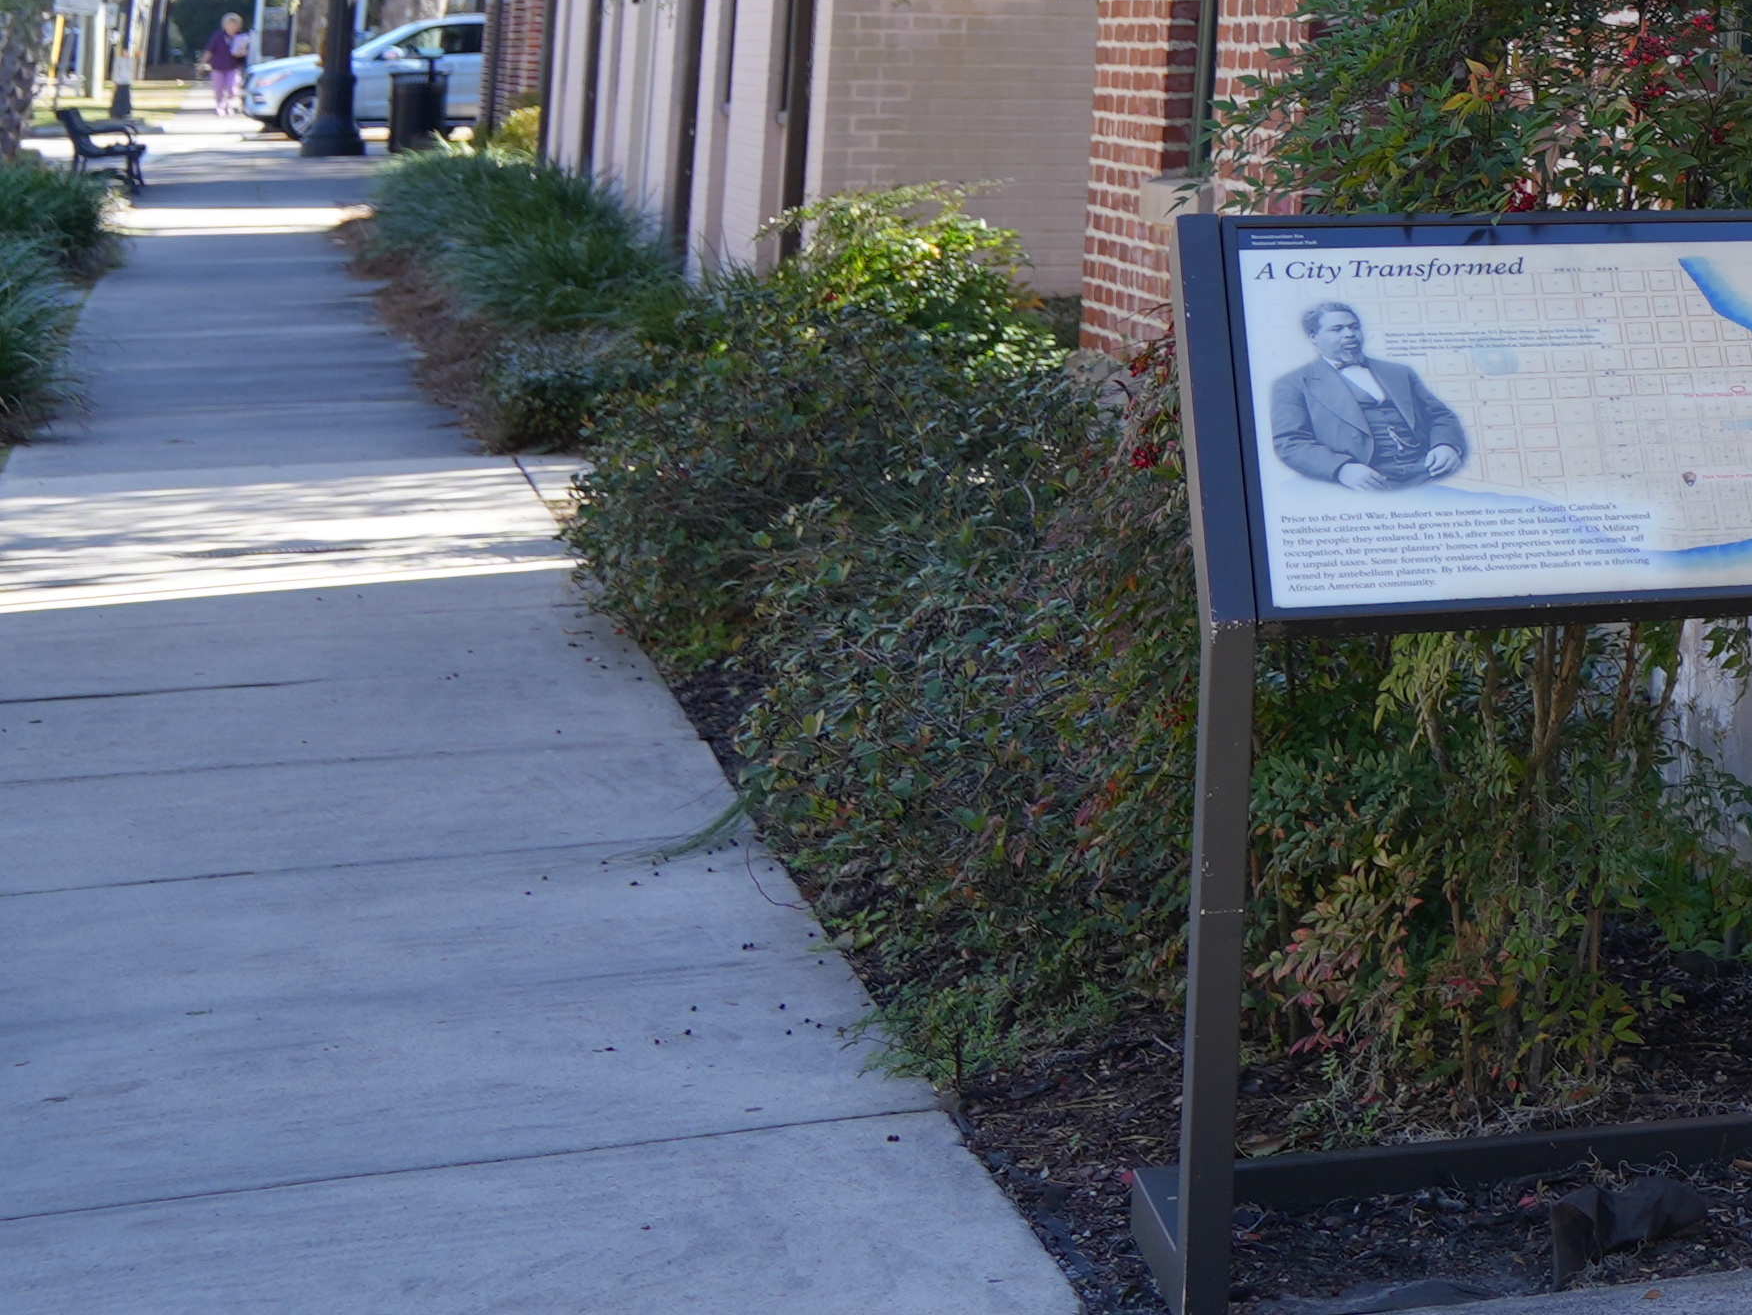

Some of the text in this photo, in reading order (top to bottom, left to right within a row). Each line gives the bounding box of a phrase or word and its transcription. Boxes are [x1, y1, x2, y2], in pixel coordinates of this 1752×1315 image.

[1254, 257, 1524, 283] A City Transformed
[1281, 515, 1305, 523] Prior
[1309, 514, 1319, 522] to
[1322, 513, 1337, 521] the
[1340, 512, 1362, 521] Civil
[1365, 512, 1388, 520] War,
[1390, 510, 1432, 519] Beaufort
[1526, 505, 1536, 513] of
[1538, 504, 1566, 513] South
[1569, 503, 1617, 511] Carolina's
[1282, 525, 1330, 534] wealthiest
[1334, 525, 1370, 533] citizens
[1373, 523, 1395, 531] who
[1398, 522, 1416, 530] had
[1418, 522, 1449, 531] grown
[1452, 519, 1471, 527] rich
[1474, 518, 1497, 526] from
[1500, 517, 1514, 525] the
[1538, 515, 1566, 523] Island
[1568, 514, 1602, 522] Cotton
[1605, 512, 1650, 521] harvested
[1284, 549, 1343, 558] occupation,
[1346, 547, 1361, 555] the
[1364, 547, 1398, 556] prewar
[1401, 543, 1443, 554] planters'
[1481, 541, 1499, 549] and
[1502, 539, 1551, 550] properties
[1579, 534, 1626, 544] auctioned
[1631, 534, 1644, 542] off
[1287, 571, 1321, 580] owned
[1324, 571, 1335, 580] by
[1338, 569, 1394, 578] antebellum
[1396, 567, 1437, 578] planters.
[1442, 565, 1453, 574] By
[1485, 563, 1537, 571] downtown
[1540, 560, 1581, 569] Beaufort
[1612, 557, 1649, 566] thriving
[1288, 578, 1436, 592] African American community.
